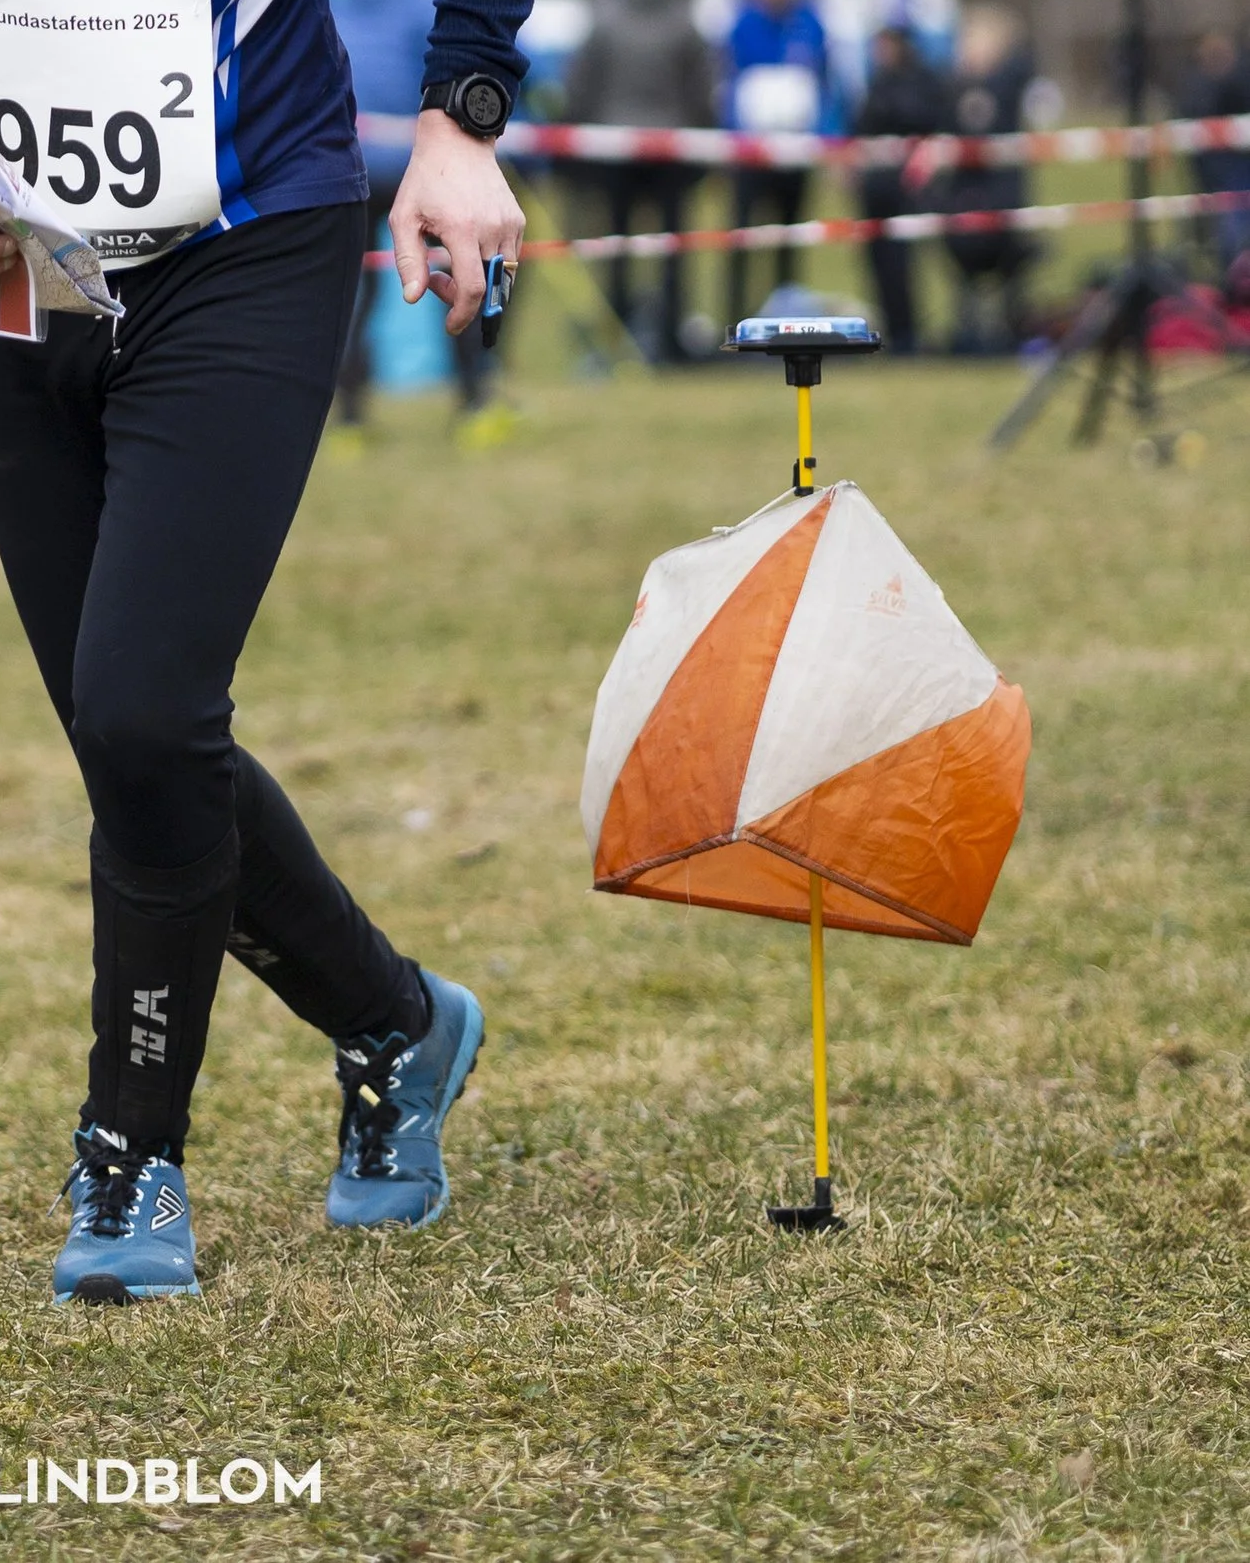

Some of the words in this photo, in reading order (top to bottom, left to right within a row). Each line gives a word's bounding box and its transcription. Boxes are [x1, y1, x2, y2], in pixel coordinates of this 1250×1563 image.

[133, 13, 180, 30] 2025
[159, 71, 195, 118] 2
[96, 231, 157, 247] NDA
